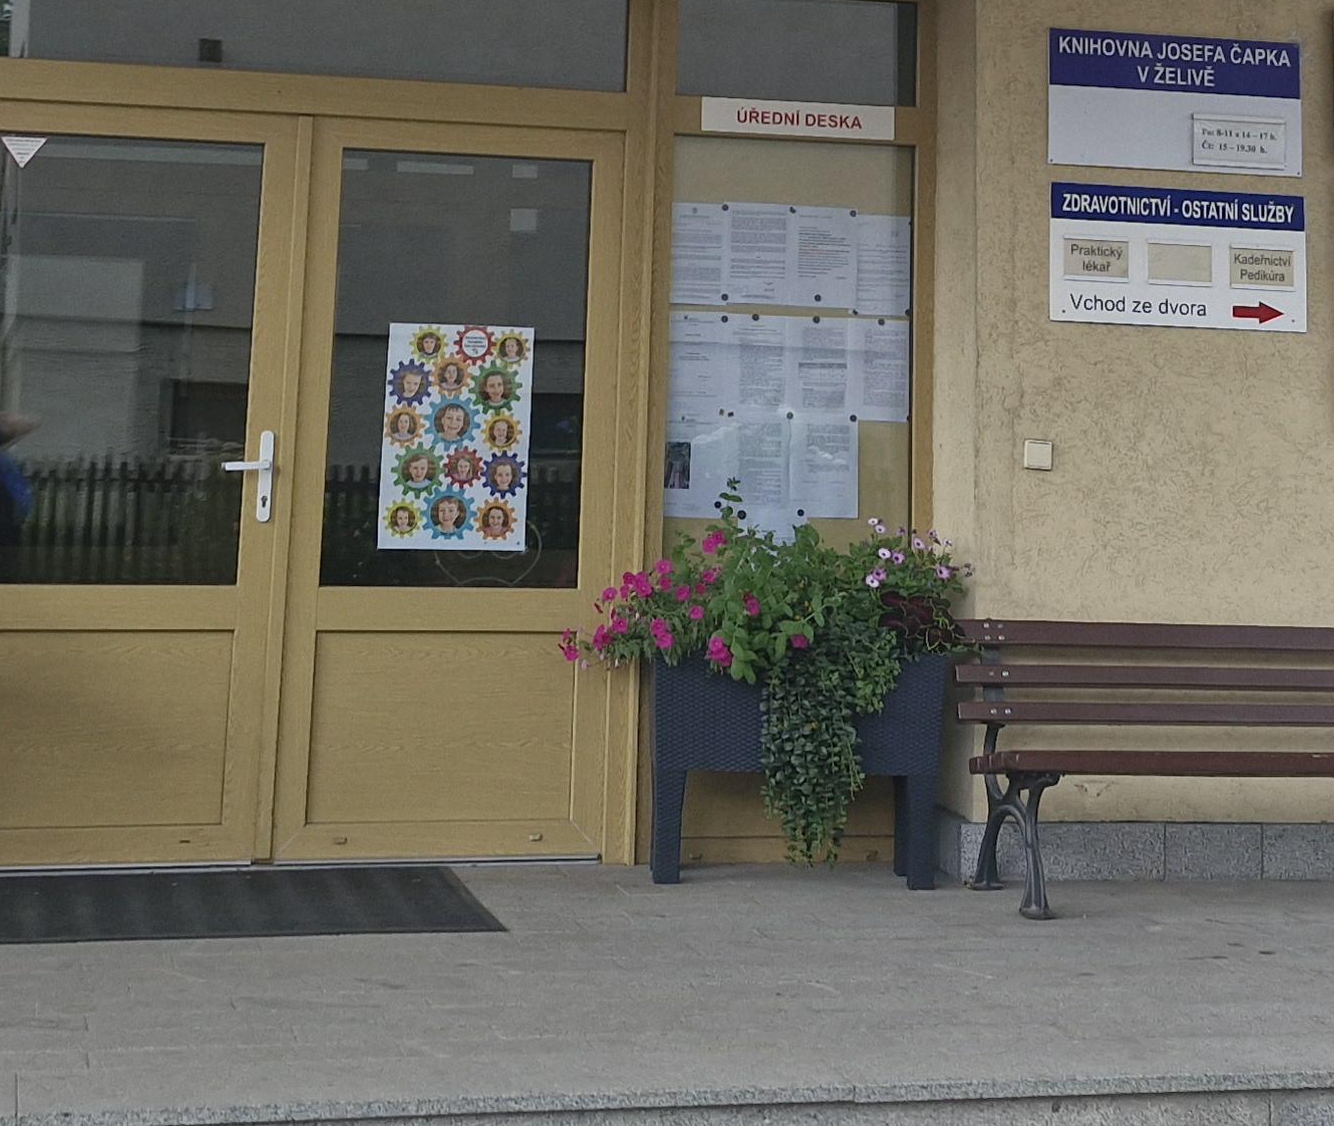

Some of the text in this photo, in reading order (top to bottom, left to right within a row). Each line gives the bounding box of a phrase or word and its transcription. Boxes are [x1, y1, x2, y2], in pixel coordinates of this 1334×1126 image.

[1058, 35, 1292, 67] KNIHOVNA JOSEFA ČAPKA
[1137, 62, 1216, 87] V ŽELIVĚ
[736, 106, 863, 130] ÚŘEDNÍ DESKA
[1062, 193, 1171, 217] ZDRAVOTNICTVÍ
[1182, 197, 1239, 221] OSTATNÍ
[1241, 199, 1294, 224] SLUŽBY
[1070, 243, 1123, 260] Praktický
[1234, 252, 1293, 269] Kadeřnictví
[1082, 258, 1112, 273] lékař
[1239, 267, 1286, 283] Pedikúra
[1069, 293, 1207, 316] Vchod ze dvora
